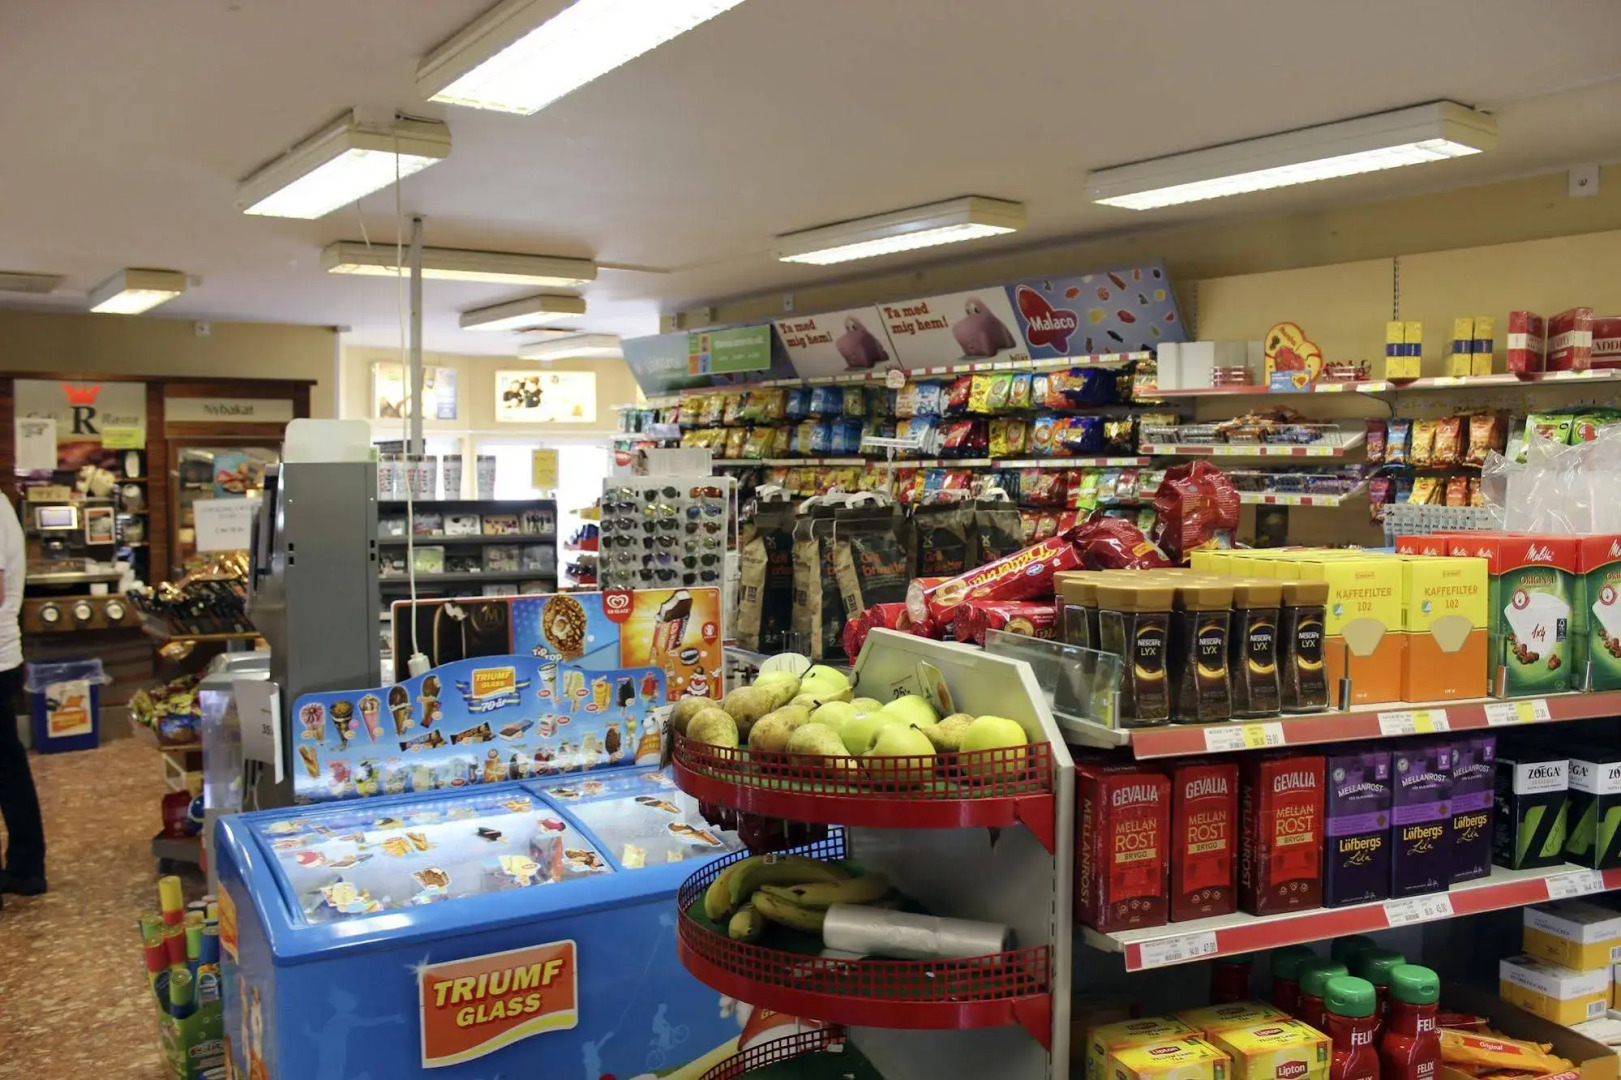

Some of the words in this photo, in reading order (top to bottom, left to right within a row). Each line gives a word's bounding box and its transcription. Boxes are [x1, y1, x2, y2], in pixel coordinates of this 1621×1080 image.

[883, 307, 901, 319] Ta
[902, 302, 930, 317] med
[779, 322, 793, 334] Ta
[794, 319, 816, 332] med
[891, 321, 916, 335] mig
[915, 315, 949, 331] hem!
[1029, 311, 1075, 331] Malaco
[787, 336, 807, 348] mig
[806, 331, 834, 345] hem!
[70, 405, 100, 435] R
[1523, 542, 1554, 562] Melitta
[1336, 586, 1392, 599] KAFFEFILTER
[1424, 585, 1478, 597] KAFFEFILTER
[1357, 602, 1372, 611] 102
[1445, 599, 1459, 609] 102
[1202, 646, 1218, 655] LYX
[1253, 642, 1268, 651] LYX
[1302, 639, 1316, 648] LYX
[1140, 647, 1156, 656] LYX
[476, 671, 511, 682] TRIUMF
[1452, 763, 1491, 778] MELLANROST
[1273, 772, 1316, 793] GEVALIA
[1401, 772, 1447, 787] MELLANROST
[1186, 777, 1228, 799] GEVALIA
[1337, 782, 1384, 797] MELLANROST
[1112, 785, 1159, 807] GEVALIA
[1188, 811, 1226, 825] MELLAN
[1276, 804, 1314, 818] MELLAN
[1115, 819, 1157, 834] MELLAN
[1276, 815, 1314, 835] ROST
[1453, 813, 1487, 830] Löfbergs
[1188, 822, 1226, 843] ROST
[1284, 835, 1305, 844] BRYGG
[1403, 825, 1443, 841] Löfbergs
[1115, 831, 1157, 851] ROST
[1196, 842, 1218, 851] BRYGG
[1339, 835, 1381, 853] Löfbergs
[1081, 798, 1093, 908] MELLANROST
[1124, 851, 1147, 860] BRYGG
[432, 958, 564, 1008] TRIUMF
[456, 992, 543, 1028] GLASS
[1257, 1028, 1282, 1037] Lipton
[1152, 1046, 1179, 1055] Lipton
[1479, 1041, 1503, 1051] Original
[1278, 1065, 1306, 1077] Lipton
[1417, 1061, 1435, 1074] FELIX
